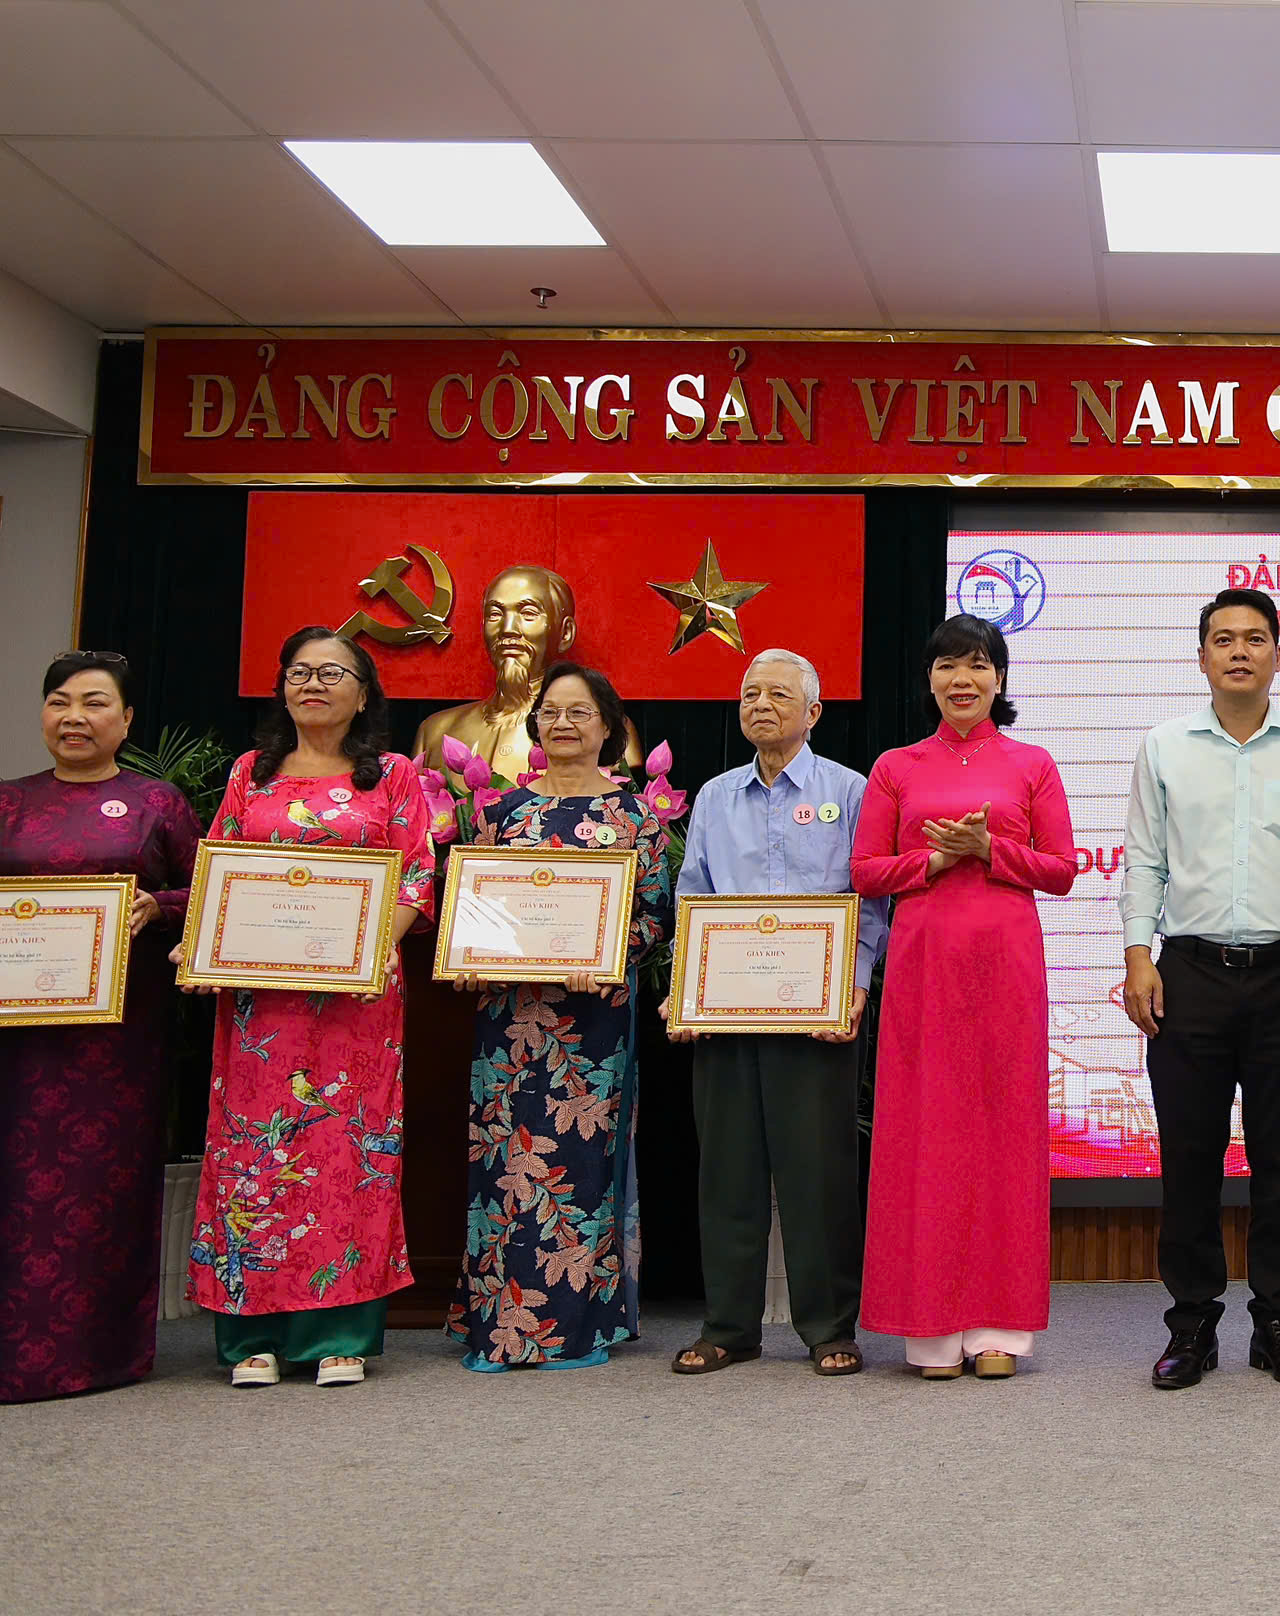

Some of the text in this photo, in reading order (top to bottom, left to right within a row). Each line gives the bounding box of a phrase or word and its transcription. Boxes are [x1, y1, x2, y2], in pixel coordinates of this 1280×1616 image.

[183, 342, 397, 441] ĐẢNG
[428, 350, 635, 462] CỘNG
[665, 345, 818, 442] SẢN
[852, 355, 1037, 462] VIỆT
[1070, 379, 1241, 445] NAM
[333, 792, 347, 800] 20
[106, 806, 121, 814] 21
[798, 810, 811, 819] 18
[826, 810, 833, 819] 2
[579, 828, 592, 836] 19
[601, 832, 609, 841] 3
